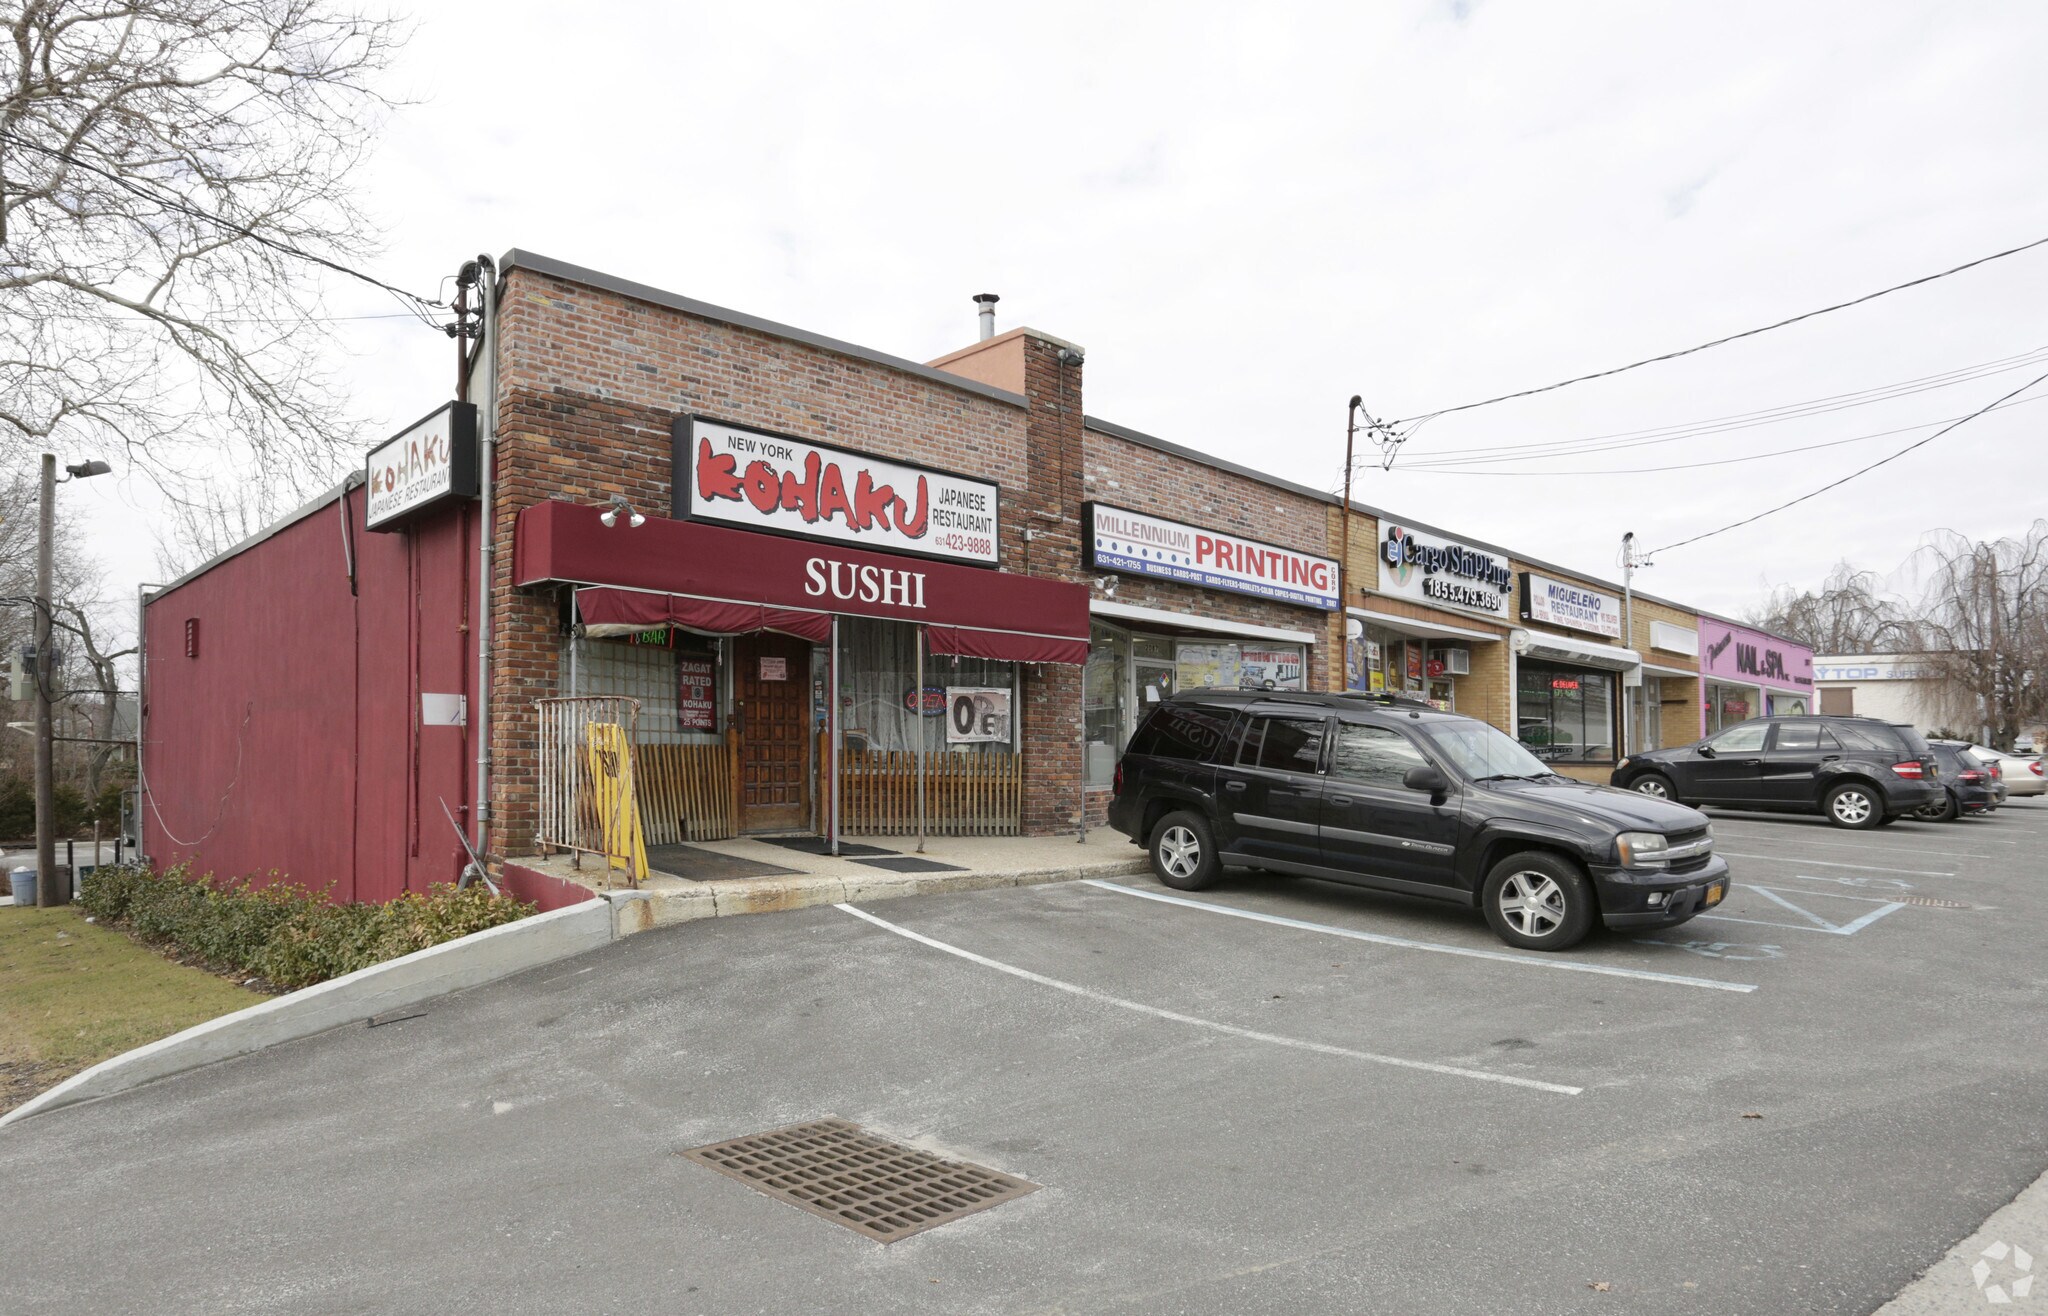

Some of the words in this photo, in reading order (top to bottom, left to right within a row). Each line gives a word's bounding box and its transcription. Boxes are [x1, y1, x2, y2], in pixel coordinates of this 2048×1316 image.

[728, 435, 756, 454] NEW
[760, 441, 793, 461] YORK
[372, 424, 450, 499] KOHAKU
[369, 490, 402, 519] JAPANESE
[404, 466, 450, 502] RESTAURANT
[696, 437, 929, 539] KOHAKU
[939, 488, 986, 512] JAPANESE
[933, 508, 992, 534] RESTAURANT
[1096, 513, 1190, 550] MILLENNIUM
[1097, 554, 1141, 570] 631-421-1755
[1195, 534, 1328, 590] PRINTING
[1402, 533, 1449, 574] Cargo
[1146, 563, 1172, 576] BUSINESS
[804, 557, 926, 608] SUSHI
[1548, 584, 1602, 611] MIGUELEÑO
[1550, 600, 1599, 623] RESTAURANT
[642, 629, 666, 645] BAR
[682, 662, 711, 674] ZAGAT
[1241, 651, 1299, 664] PRINTING
[1736, 642, 1760, 676] NAIL
[1766, 649, 1785, 680] SPA
[682, 675, 712, 687] RATED
[682, 700, 712, 709] KOHAKU
[906, 693, 947, 708] OPEN
[683, 718, 691, 726] 25
[691, 719, 712, 727] POINTS
